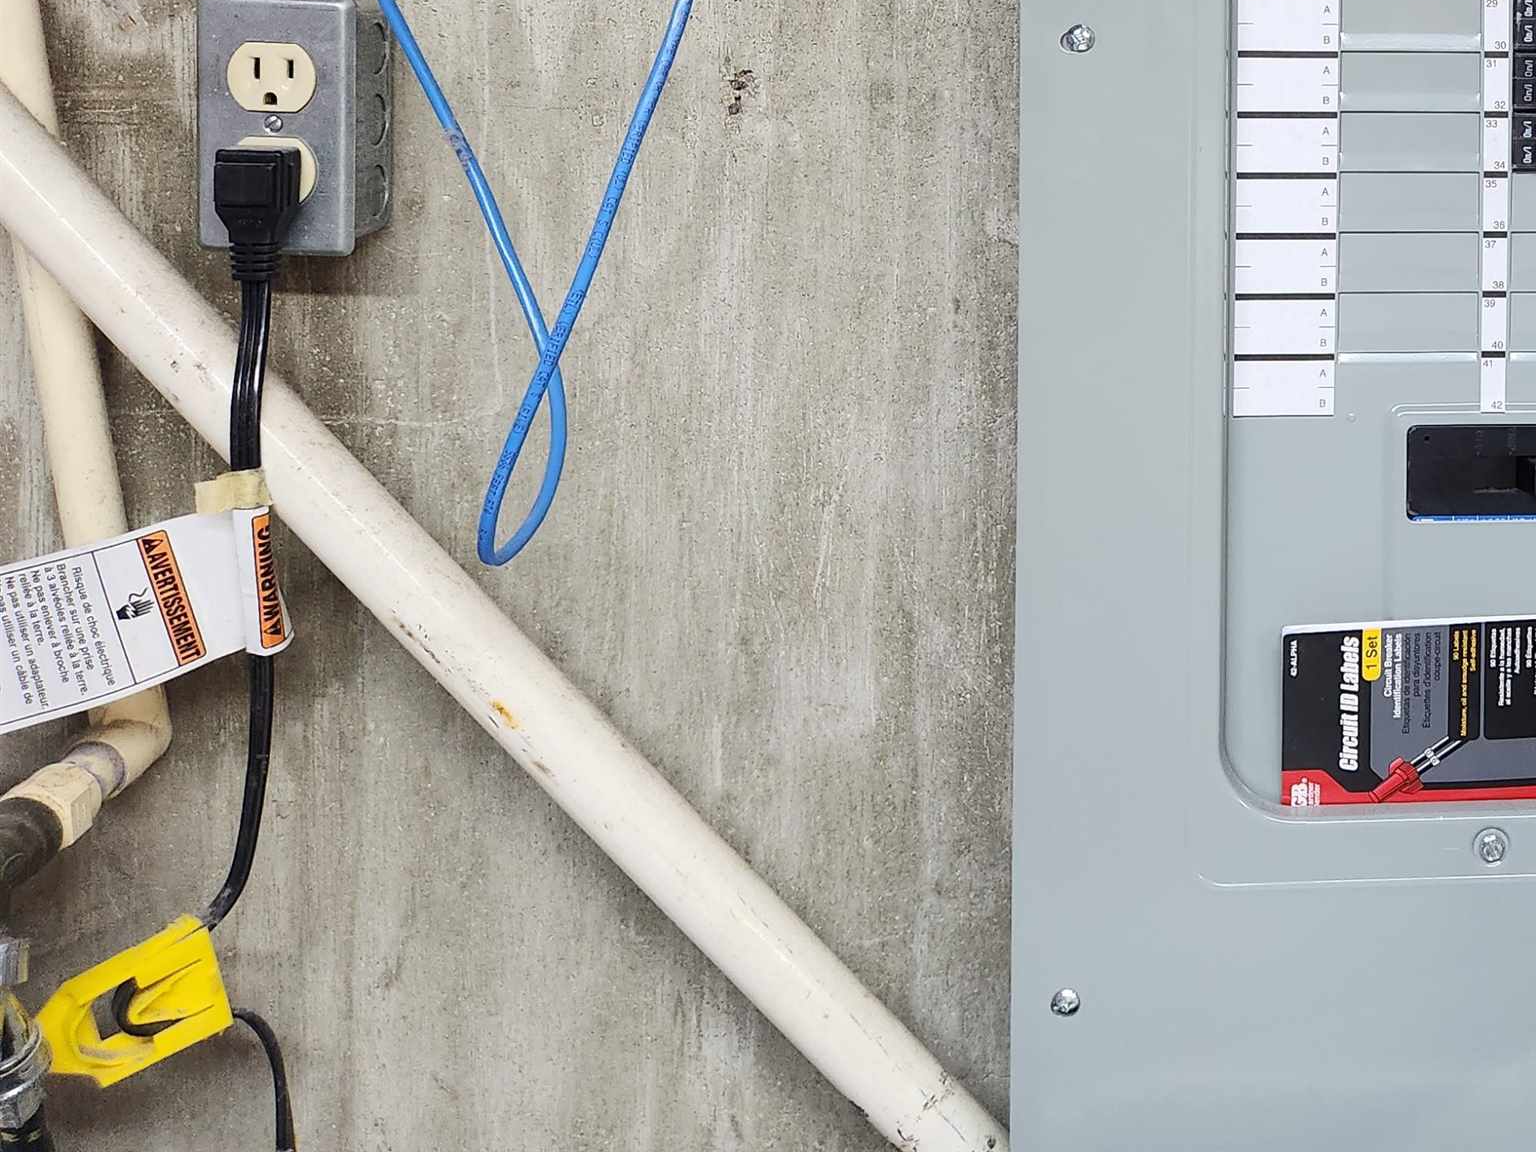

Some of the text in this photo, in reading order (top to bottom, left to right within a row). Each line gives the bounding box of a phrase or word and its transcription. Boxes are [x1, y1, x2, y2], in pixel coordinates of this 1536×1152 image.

[1486, 0, 1498, 8] 29
[1494, 40, 1507, 50] 30
[1494, 99, 1506, 109] 32
[1486, 120, 1497, 128] 33
[1493, 160, 1505, 170] 34
[1485, 179, 1497, 188] 35
[1493, 220, 1505, 230] 36
[1485, 240, 1496, 248] 37
[1484, 299, 1496, 308] 39
[1491, 340, 1503, 349] 40
[1491, 400, 1503, 409] 42
[4, 575, 16, 589] Ne
[30, 569, 41, 583] Ne
[257, 524, 283, 621] WARNING
[7, 590, 20, 609] pas
[33, 585, 46, 603] pas
[147, 547, 202, 661] AVERTISSEMENT
[18, 572, 33, 599] reliée
[31, 619, 46, 645] terre.
[56, 562, 94, 671] Brancher sur une prise
[0, 614, 18, 648] utiliser
[14, 609, 31, 642] utiliser
[40, 604, 58, 639] enlever
[70, 566, 116, 686] Risque de choc électrique
[48, 582, 68, 622] alvéoles
[60, 623, 76, 650] reliée
[74, 670, 89, 695] terre.
[1367, 636, 1377, 658] Set
[1394, 633, 1402, 661] Labels
[11, 649, 21, 662] un
[24, 643, 34, 656] un
[1433, 632, 1441, 680] coupe-circuit
[53, 649, 71, 683] broche
[1413, 633, 1422, 697] para disyuntores
[15, 663, 31, 690] câble
[1384, 670, 1392, 697] Circuit
[1423, 632, 1432, 728] Etiquettes d'identification
[23, 691, 34, 704] de
[1403, 686, 1410, 695] de
[1340, 636, 1359, 771] Circuit ID Labels
[1403, 698, 1411, 734] Etiquetas
